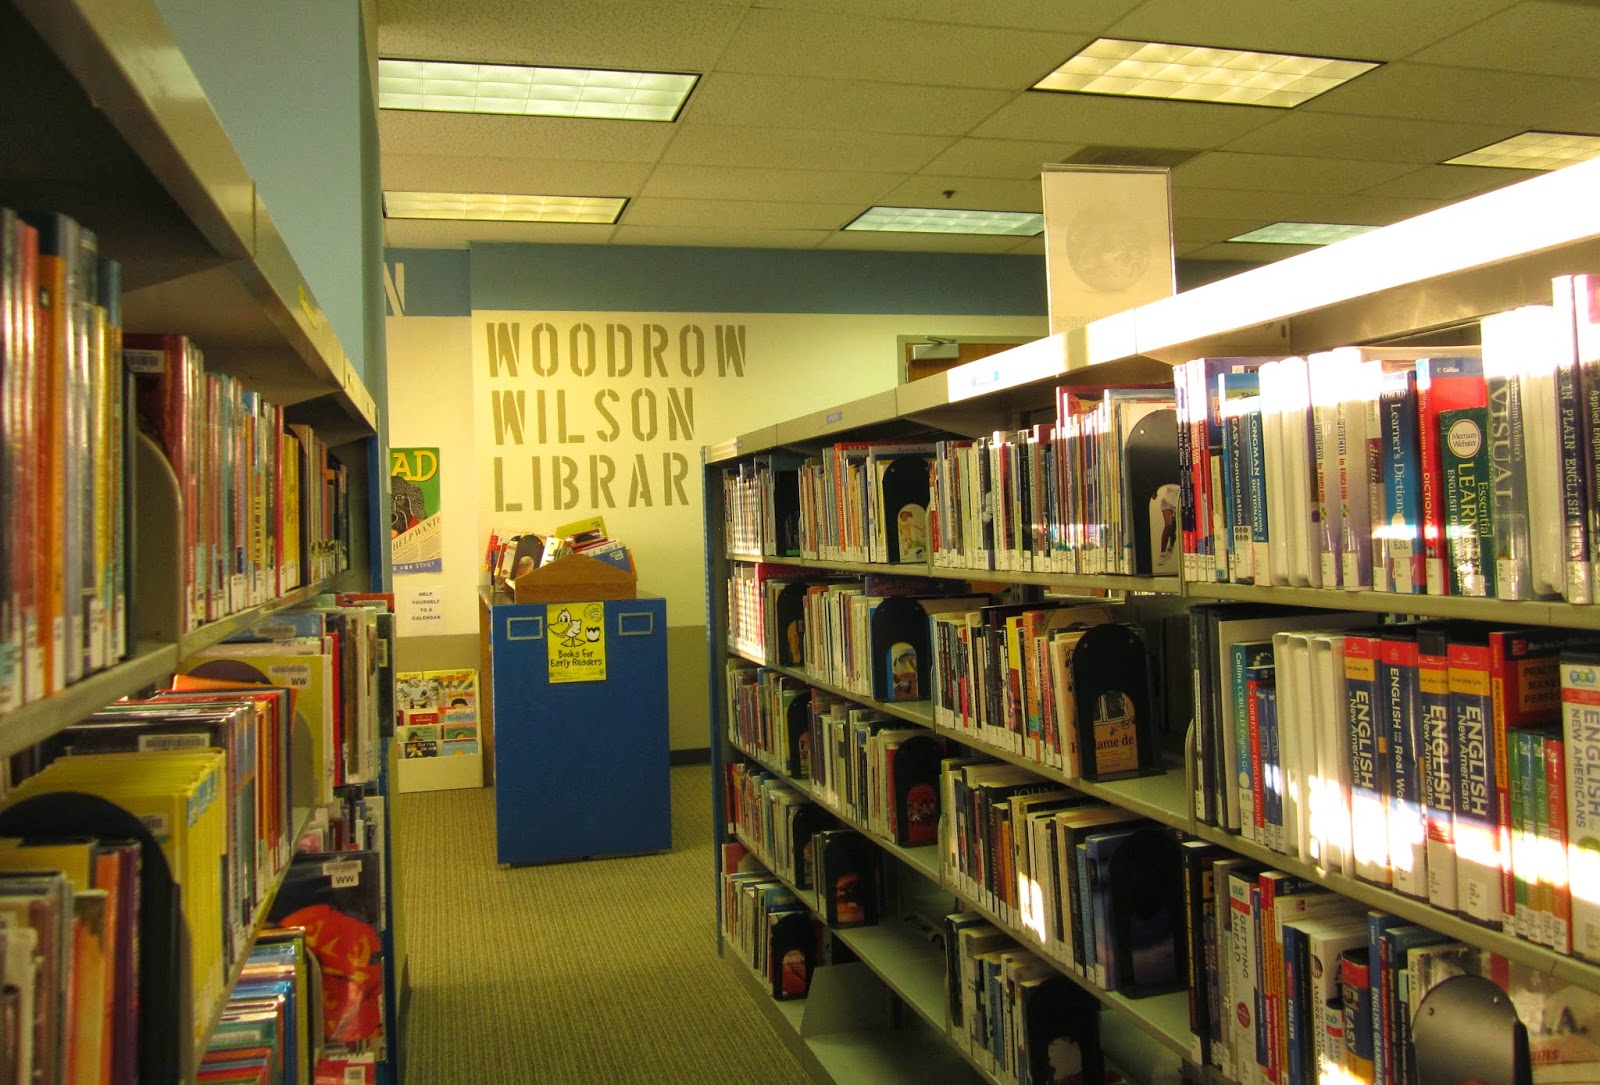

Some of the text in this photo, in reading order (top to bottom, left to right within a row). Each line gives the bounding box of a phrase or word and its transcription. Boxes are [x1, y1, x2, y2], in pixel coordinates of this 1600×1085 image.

[486, 322, 746, 378] WOODROW
[491, 387, 695, 445] WILSON
[1561, 384, 1572, 400] IN
[1590, 390, 1600, 429] Applied
[1250, 412, 1261, 476] LONGMAN
[1453, 440, 1476, 448] Webster
[1490, 383, 1513, 506] VISUAL
[1563, 408, 1576, 450] PLAIN
[493, 452, 690, 512] LIBRAR
[1231, 418, 1243, 526] EASY Pronunciation
[1391, 403, 1406, 515] Learner's Dictiona
[1251, 479, 1259, 532] DICTIONARY
[1423, 472, 1434, 542] DICTIONAY
[1447, 469, 1457, 511] ENGLISH
[1478, 482, 1491, 539] Essential
[1565, 458, 1579, 516] ENGLISH
[550, 658, 603, 669] Early Readers
[558, 648, 594, 659] Books For
[291, 677, 307, 685] WW
[1237, 685, 1245, 727] COBUILD
[1390, 667, 1402, 729] ENGLISH
[1349, 697, 1357, 724] New
[1423, 713, 1431, 741] New
[1458, 714, 1466, 743] New
[1121, 735, 1134, 746] de
[1239, 729, 1247, 759] English
[1350, 726, 1361, 785] Americans
[1355, 690, 1374, 788] ENGLISH
[1394, 745, 1404, 775] Real
[1430, 704, 1452, 811] ENGLISH
[1465, 705, 1487, 816] ENGLISH
[1584, 709, 1600, 818] ENGLISH
[1424, 742, 1434, 807] Americans
[1459, 745, 1470, 811] Americans
[1571, 708, 1585, 828] NEW AMERICANS
[336, 876, 354, 884] WW
[1232, 910, 1241, 963] AHEAD
[1240, 914, 1249, 980] GETTING
[1287, 999, 1295, 1040] ENGLISH
[1313, 984, 1321, 1037] AMERICAN
[1345, 1007, 1356, 1053] EASY
[1371, 986, 1380, 1030] ENGLISH
